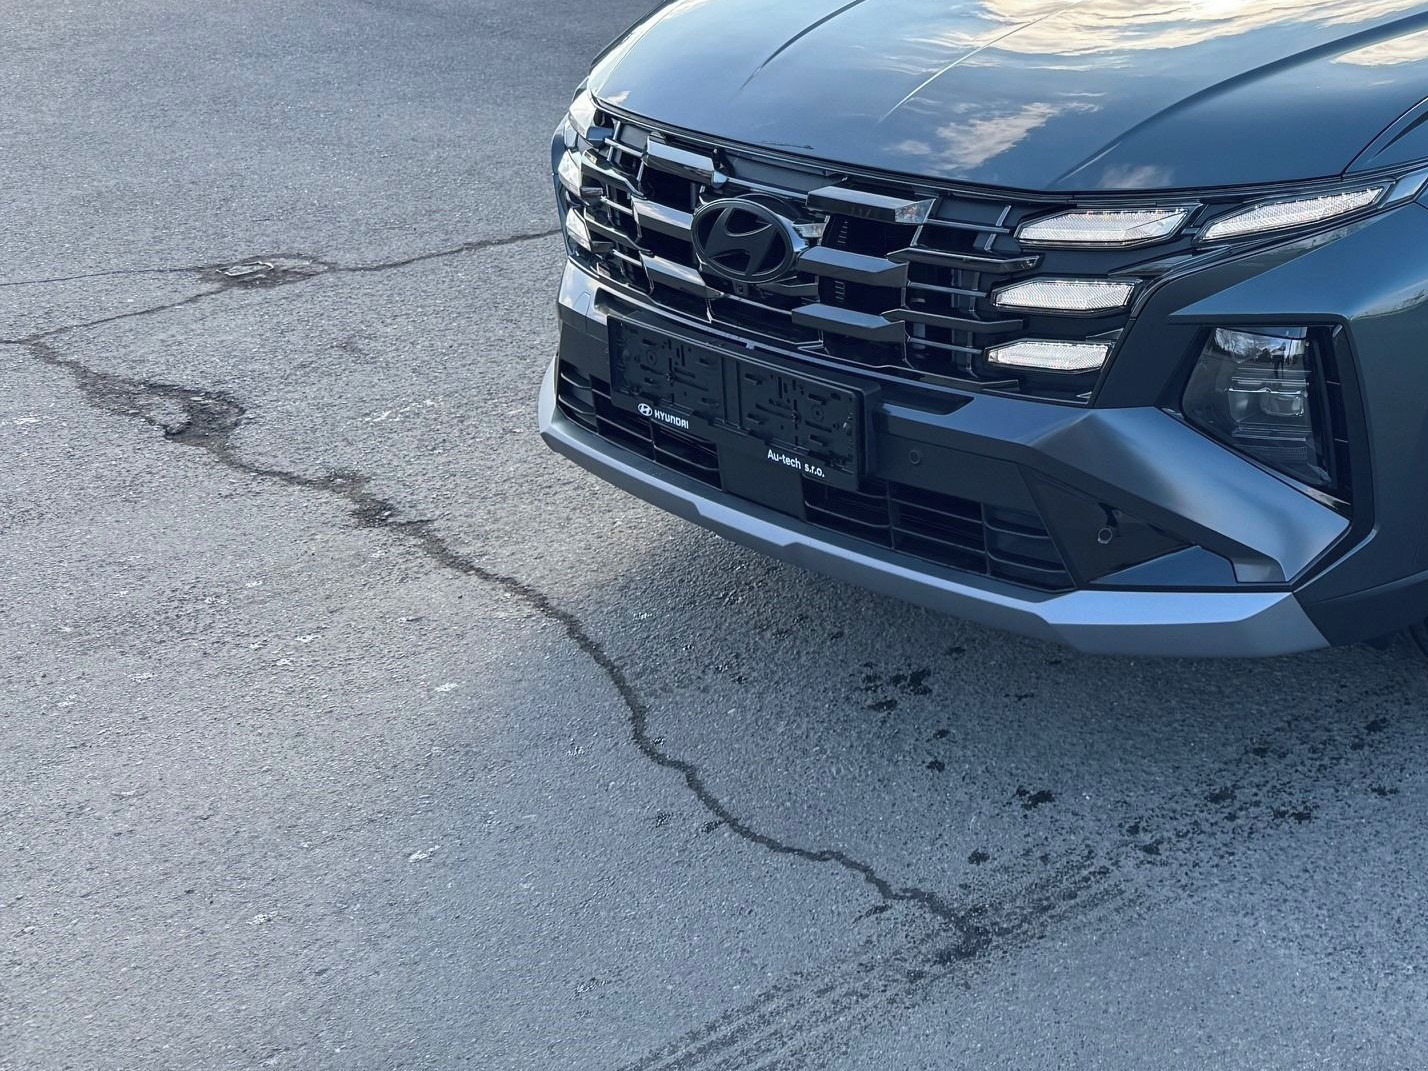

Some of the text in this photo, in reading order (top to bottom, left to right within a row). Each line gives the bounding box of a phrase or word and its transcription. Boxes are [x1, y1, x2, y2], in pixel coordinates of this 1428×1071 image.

[654, 409, 689, 430] HYUNDAI
[767, 449, 825, 478] Au-tech s.r.o.
